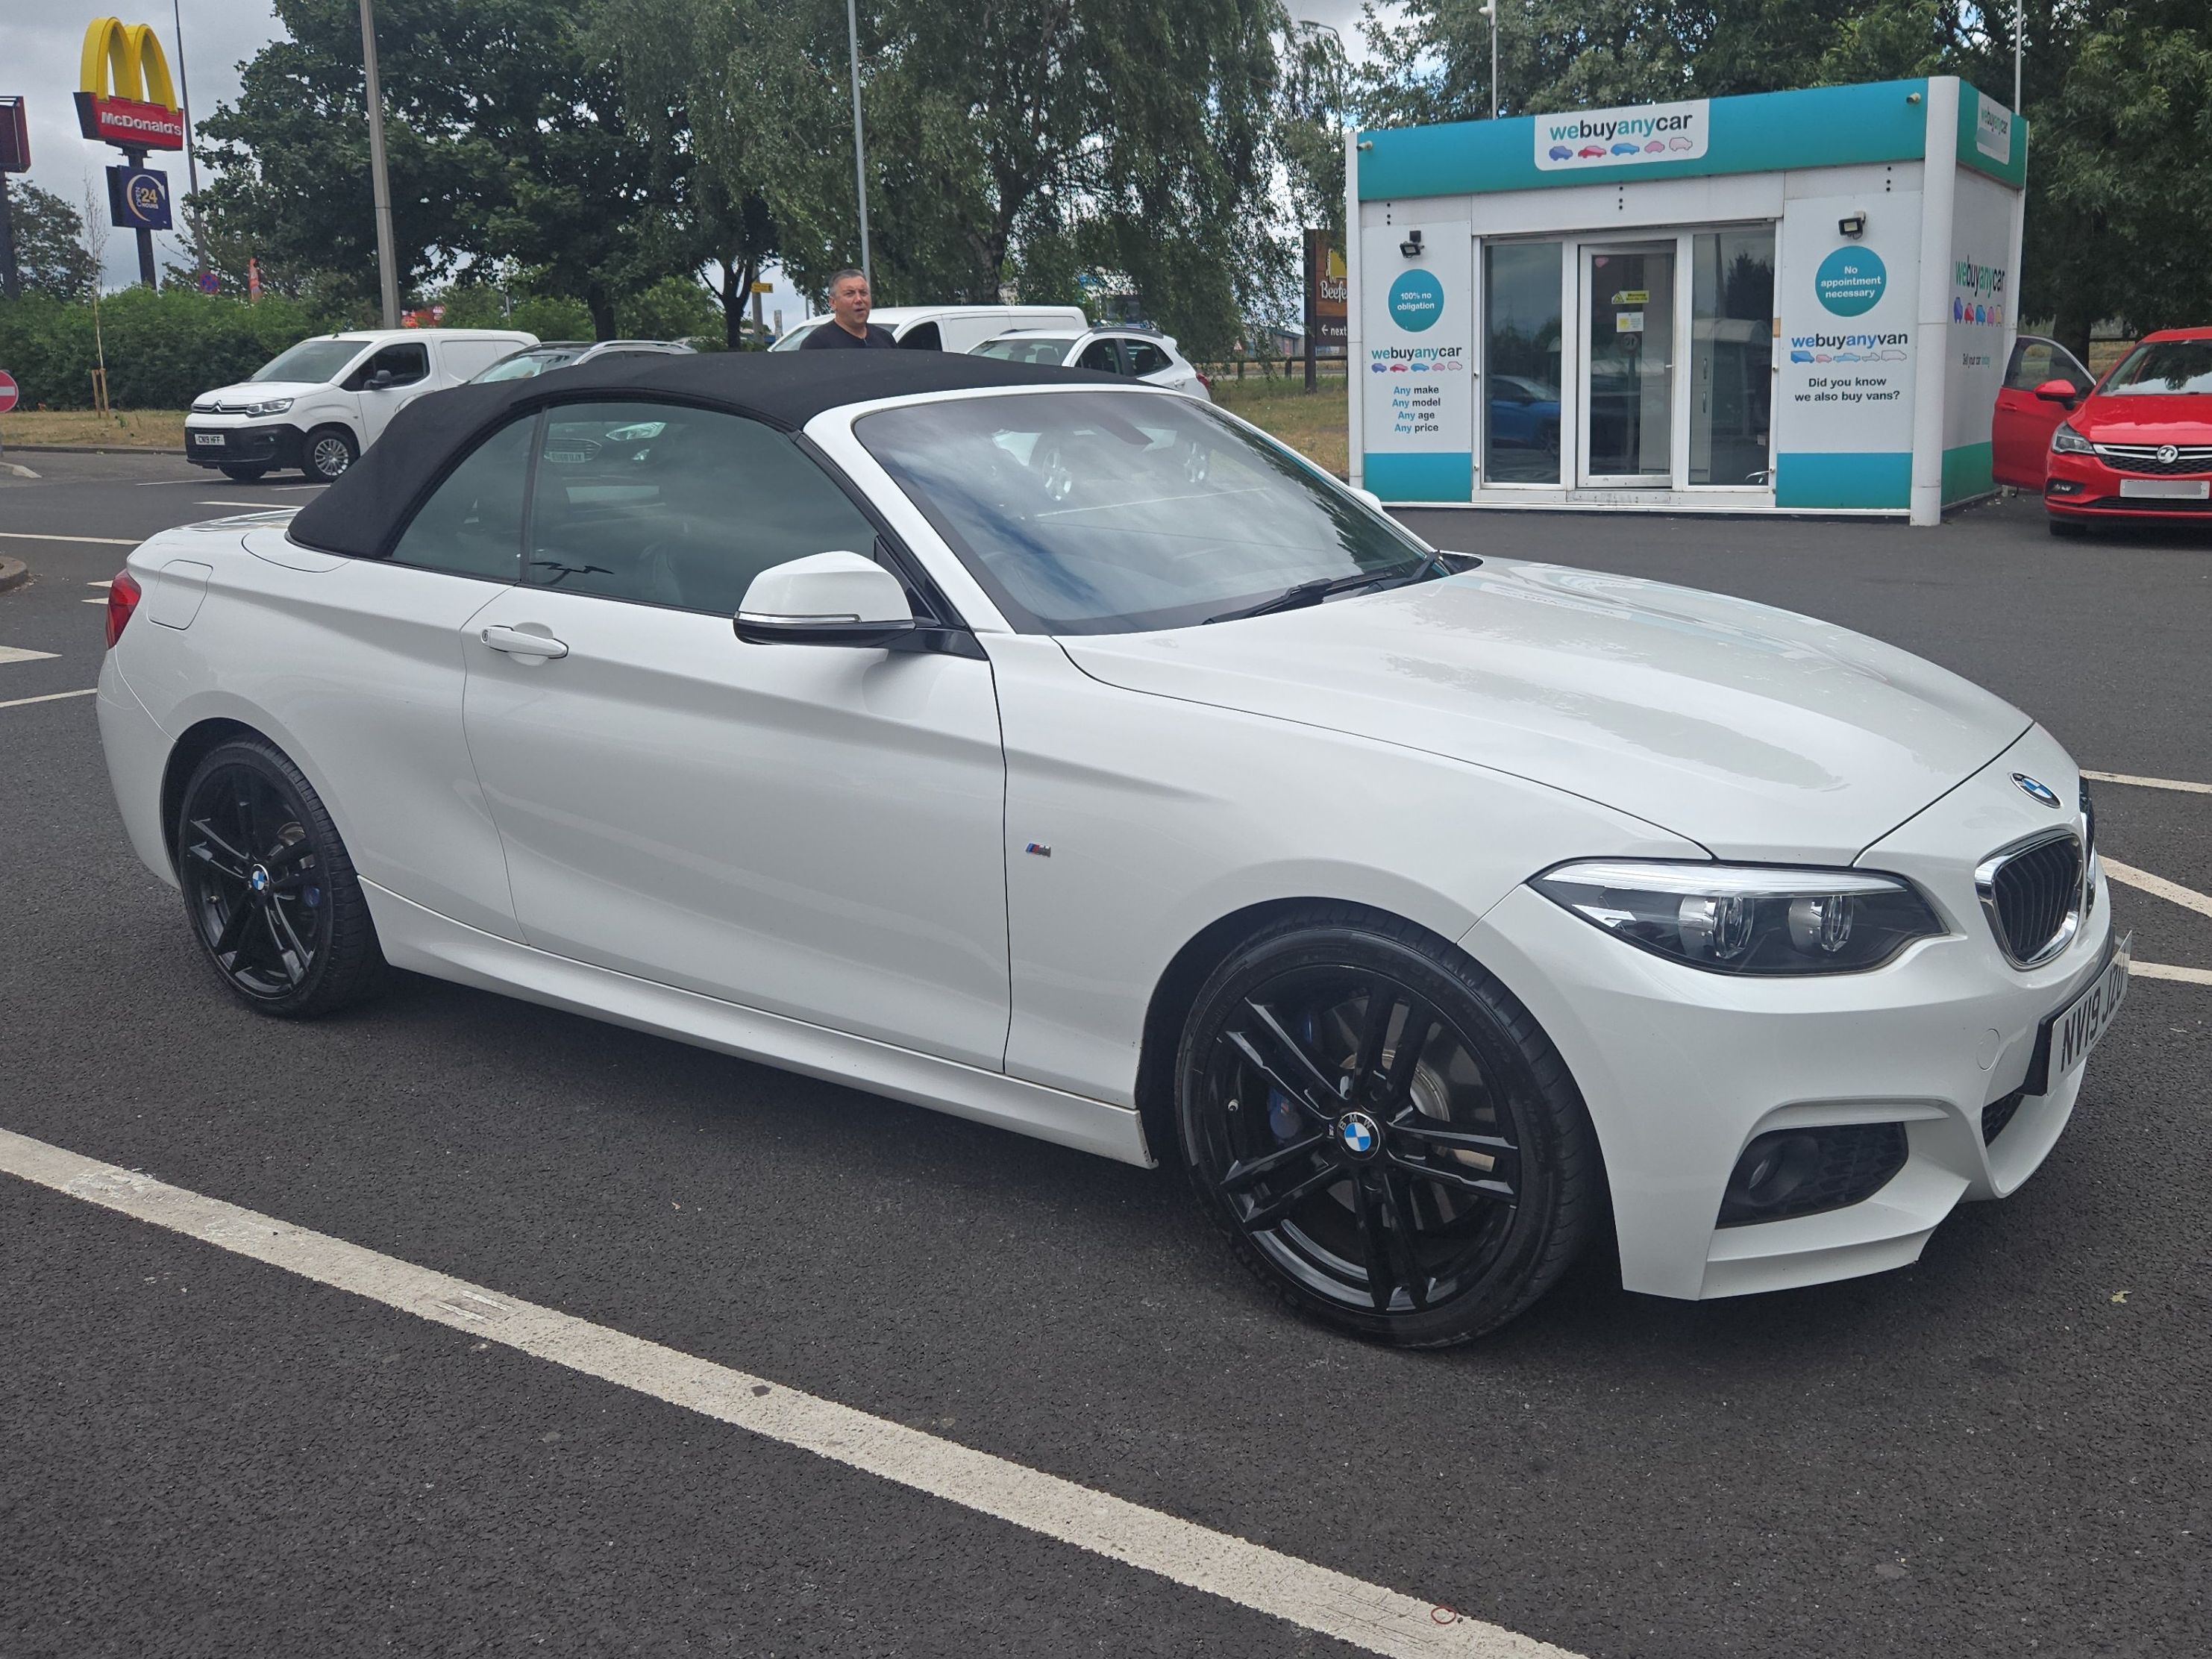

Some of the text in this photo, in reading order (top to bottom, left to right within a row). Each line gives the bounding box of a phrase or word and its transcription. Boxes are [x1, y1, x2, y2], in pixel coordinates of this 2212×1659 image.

[101, 111, 182, 136] McDonald's
[1550, 114, 1693, 141] webuyanycar
[140, 187, 158, 204] 24
[1844, 266, 1858, 275] No
[1955, 255, 2005, 298] webuyanycar
[1820, 275, 1882, 288] appointment
[1825, 289, 1876, 298] necessary
[1397, 301, 1435, 311] obligation
[1330, 323, 1348, 336] next
[1791, 333, 1908, 350] webuyanyvan
[1371, 347, 1462, 362] webuyanycar
[1808, 377, 1887, 389] Did you know
[1393, 386, 1439, 396] Any make
[1794, 390, 1900, 403] we also buy vans?
[1392, 398, 1441, 409] Any model
[1397, 411, 1435, 421] Any age
[1394, 423, 1439, 434] Any price
[2061, 985, 2101, 1073] NV19
